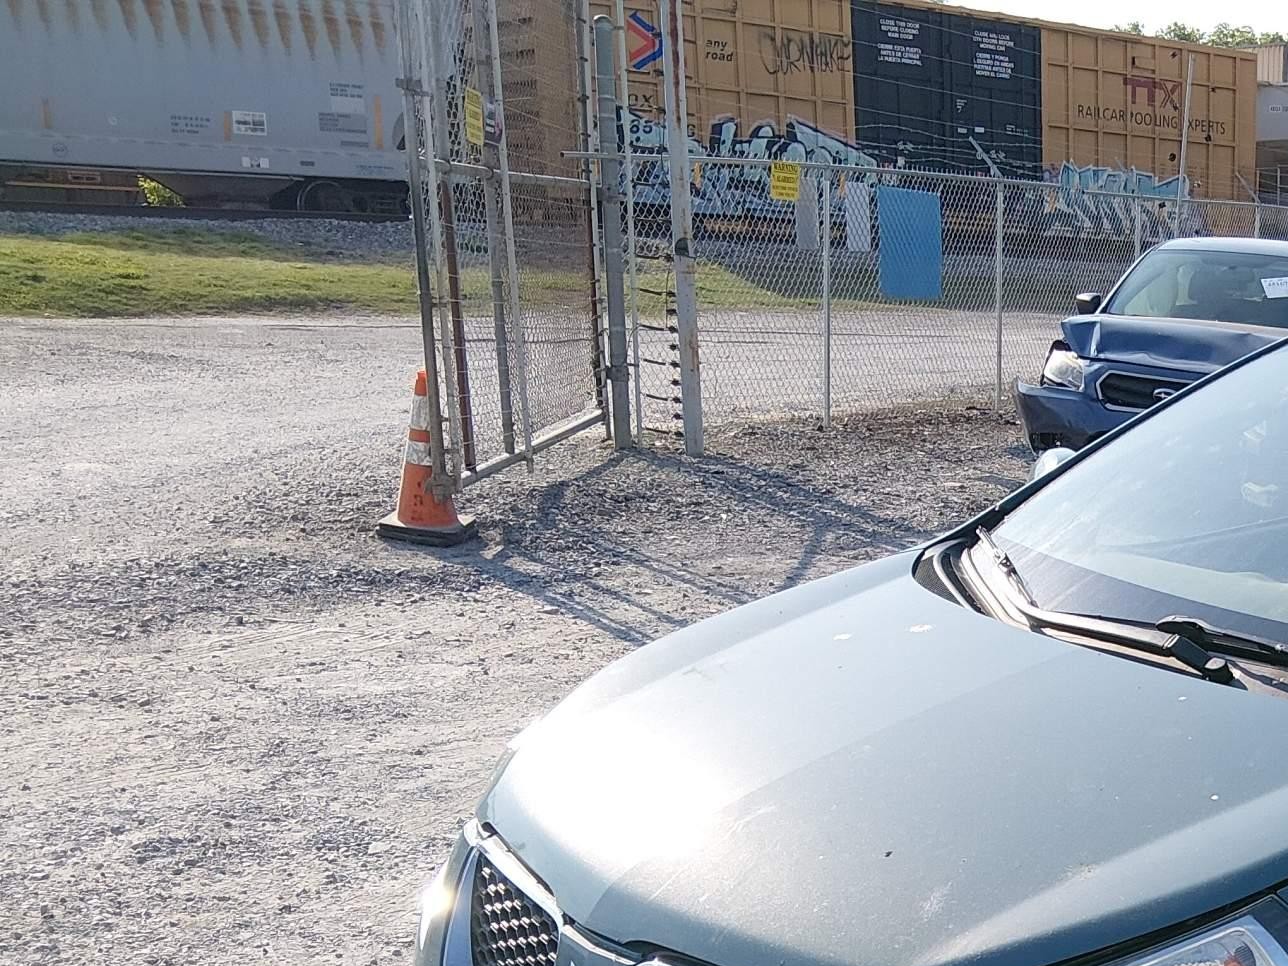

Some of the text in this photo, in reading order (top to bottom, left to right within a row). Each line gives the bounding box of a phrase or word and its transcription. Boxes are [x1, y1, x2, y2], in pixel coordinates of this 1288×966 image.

[705, 39, 728, 51] any
[705, 51, 734, 62] road
[1077, 104, 1226, 136] RAILCAR POOLING XPERTS
